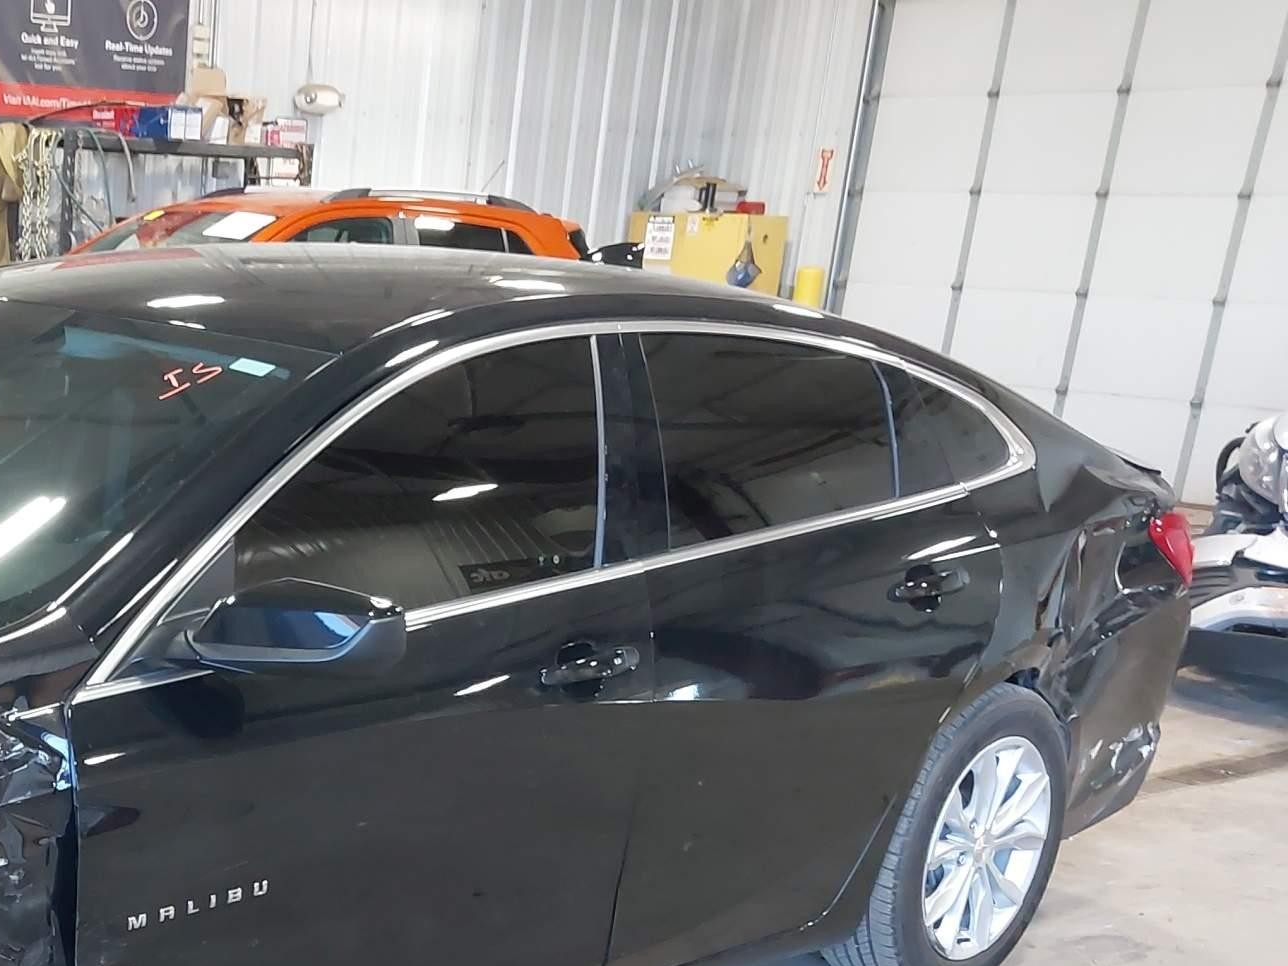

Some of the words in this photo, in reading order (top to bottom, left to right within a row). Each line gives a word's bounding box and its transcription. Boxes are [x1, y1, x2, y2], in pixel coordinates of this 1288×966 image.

[21, 32, 42, 45] Quick
[43, 35, 59, 46] and
[60, 35, 79, 50] Easy
[105, 39, 143, 54] Real-Time
[144, 43, 173, 57] Updates
[3, 93, 22, 106] Visit
[127, 879, 269, 931] MALIBU
